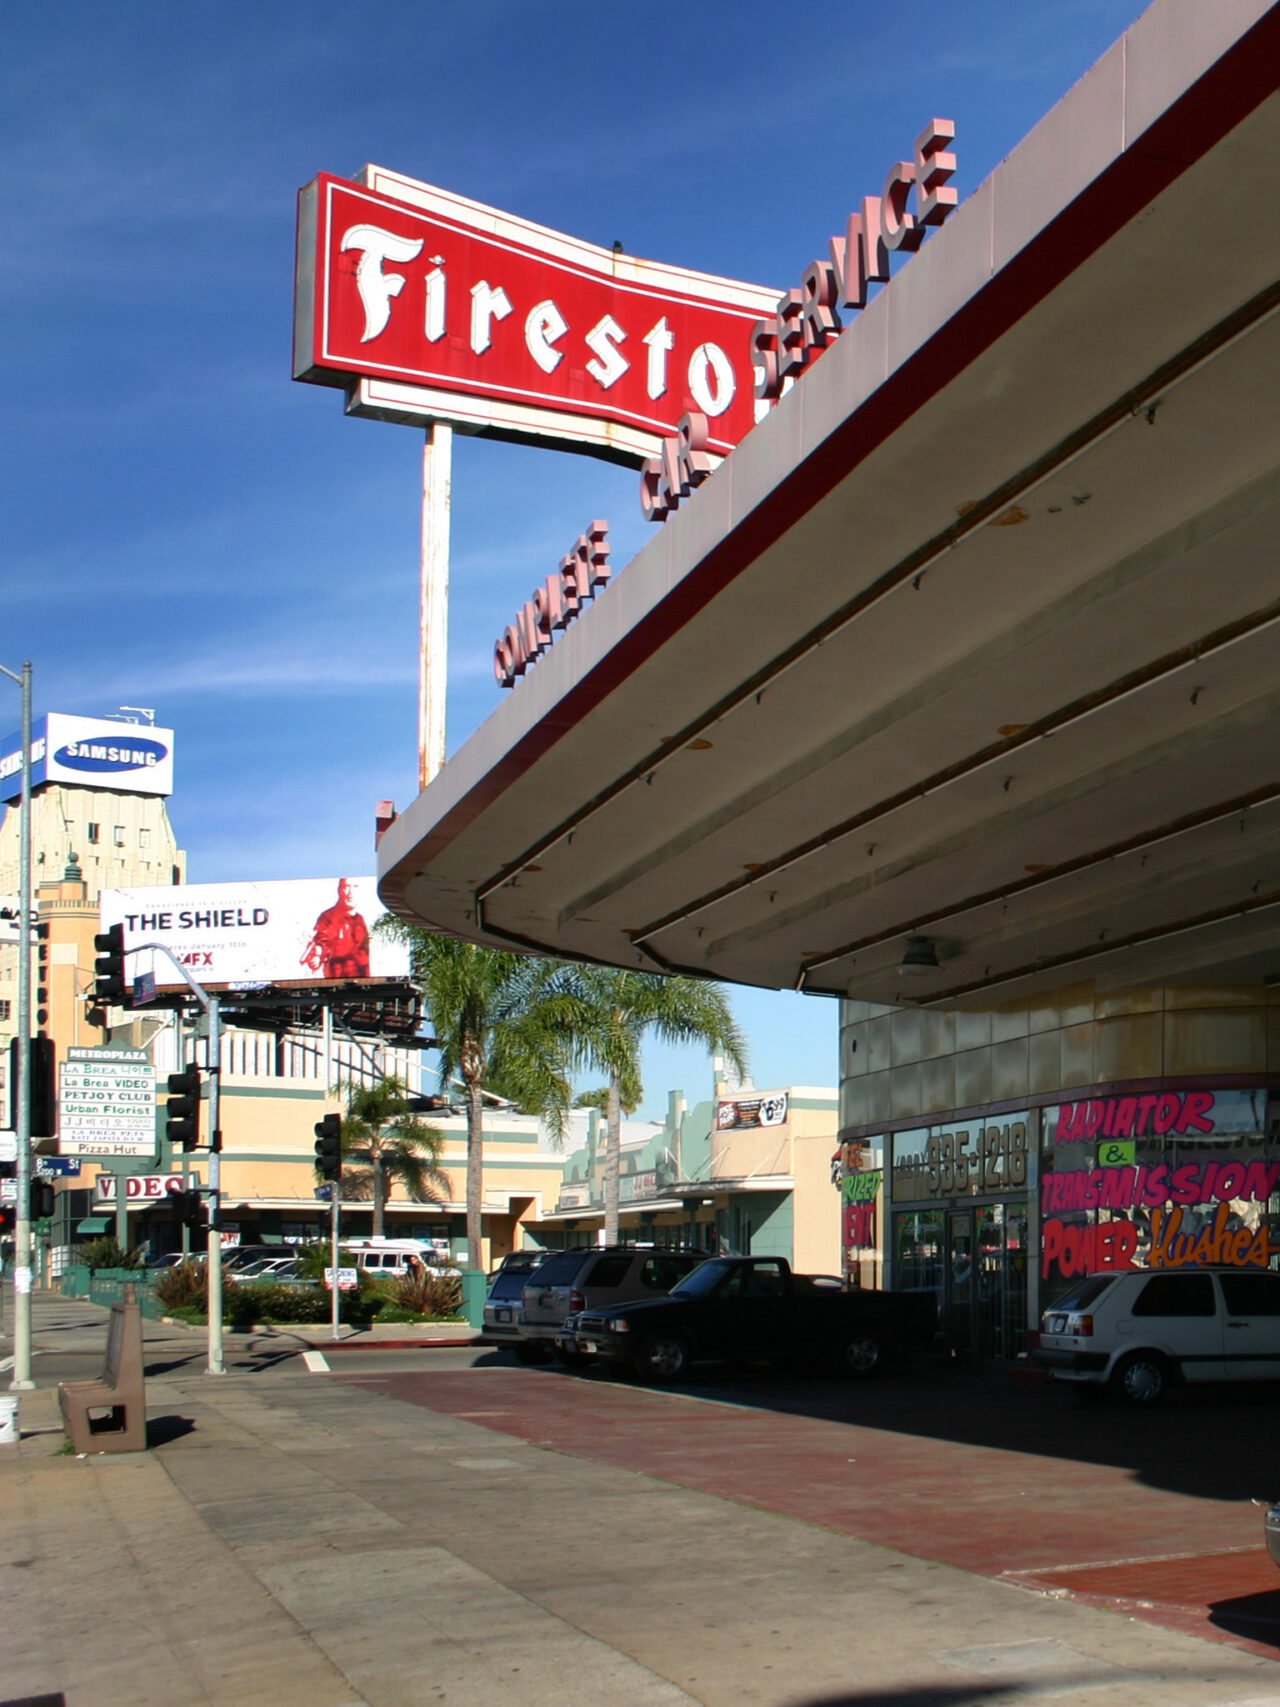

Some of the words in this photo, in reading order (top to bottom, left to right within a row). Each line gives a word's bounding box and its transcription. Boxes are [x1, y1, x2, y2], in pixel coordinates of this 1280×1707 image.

[751, 118, 958, 399] SERVICE
[340, 224, 797, 425] Firesto
[640, 411, 714, 522] CAR
[494, 519, 611, 689] COMPLETE
[66, 742, 157, 767] SAMSUNG
[125, 912, 173, 932] THE
[178, 908, 270, 929] SHIELD
[69, 1049, 147, 1060] METROPLAZA
[64, 1078, 77, 1086] La
[83, 1079, 109, 1087] Brea
[115, 1079, 149, 1088] VIDEO
[119, 1092, 151, 1101] CLUB
[65, 1104, 99, 1113] Urban
[104, 1105, 150, 1115] Florist
[1055, 1091, 1215, 1143] RADIATOR
[78, 1144, 109, 1154] Pizza
[114, 1145, 137, 1154] Hut
[1105, 1146, 1128, 1163] &
[69, 1158, 79, 1170] St
[100, 1178, 185, 1197] VDEO
[842, 1171, 880, 1201] RIZED
[1041, 1217, 1139, 1281] POWER
